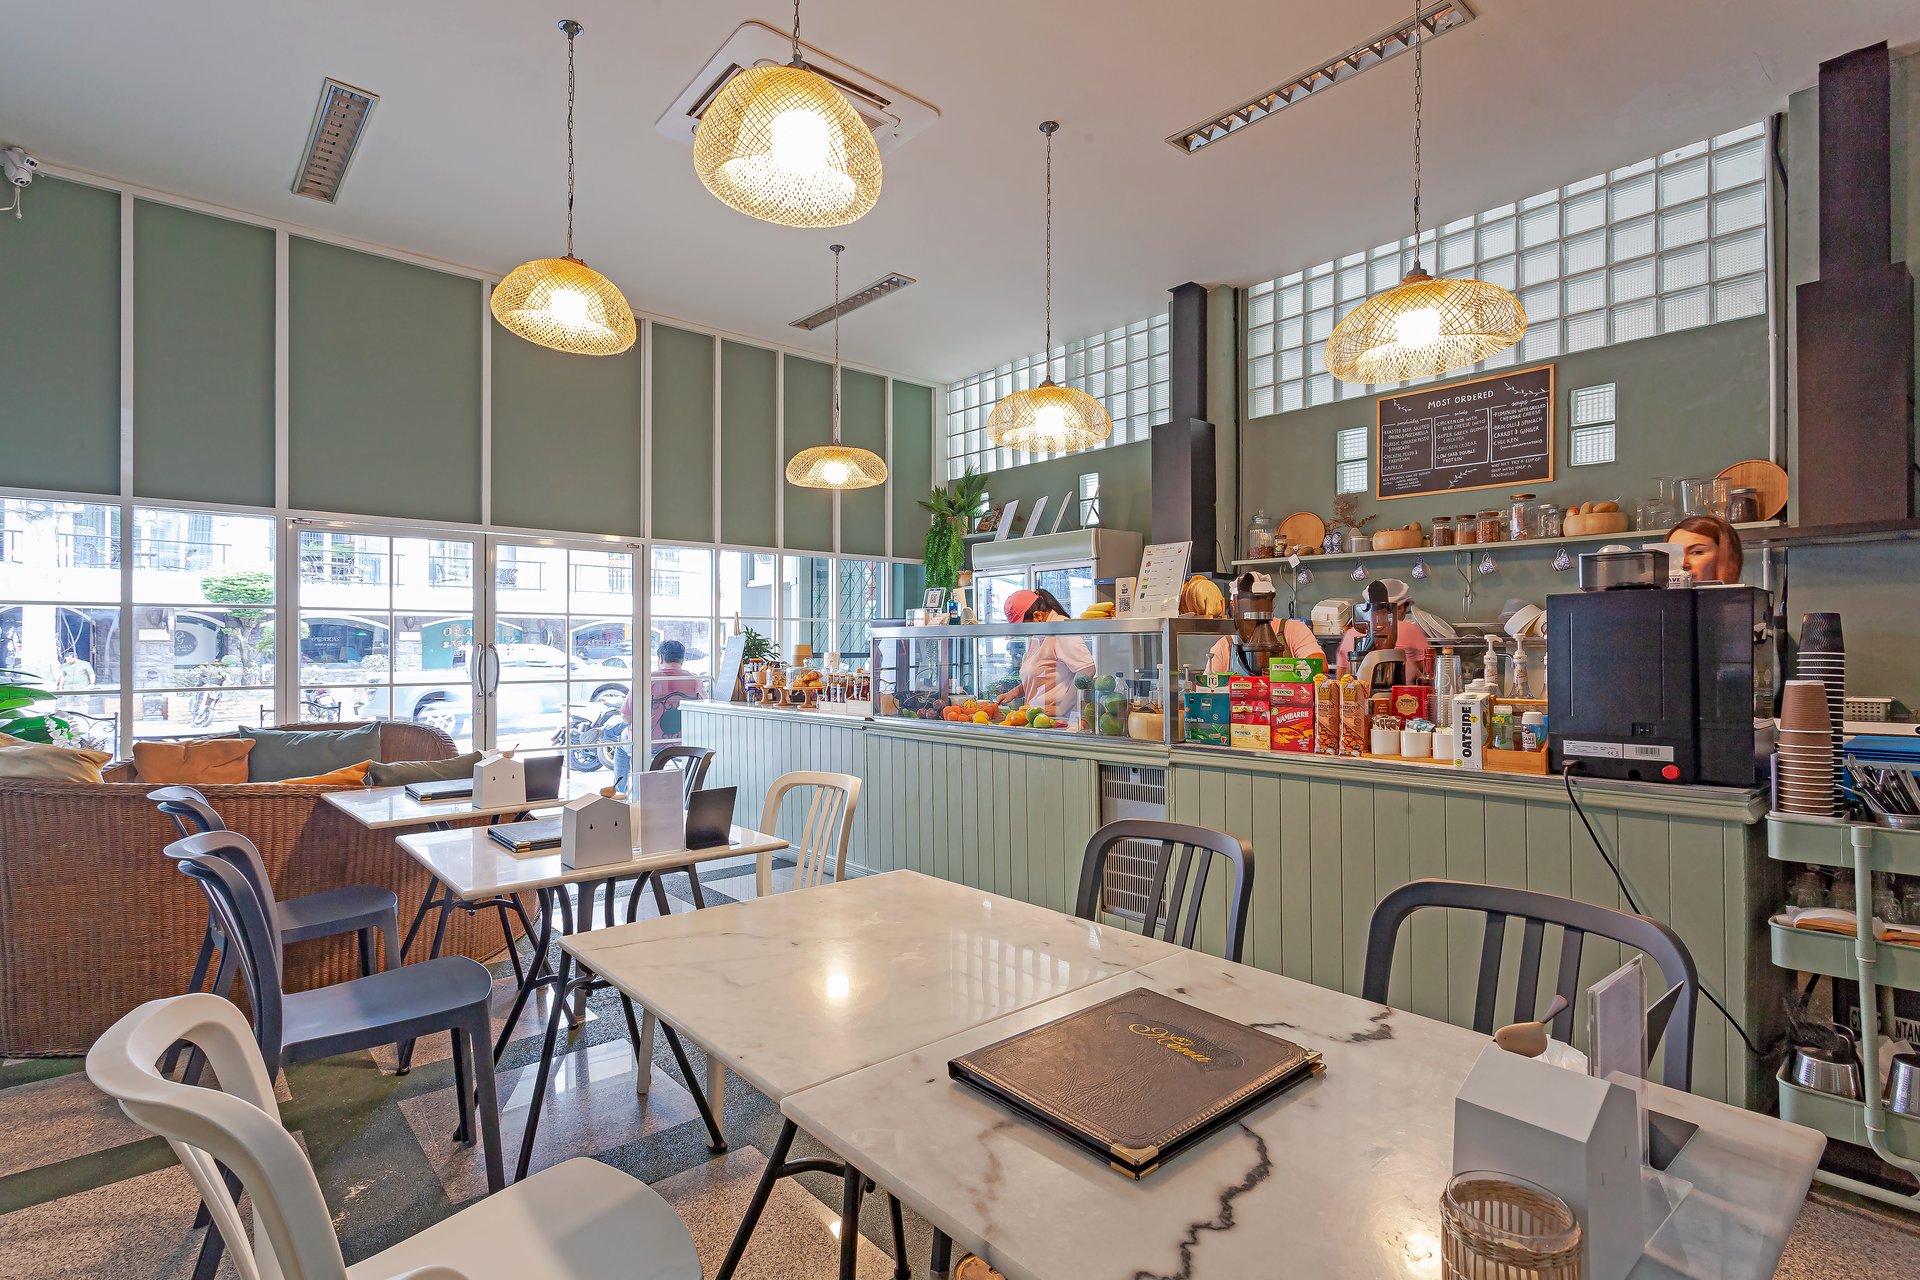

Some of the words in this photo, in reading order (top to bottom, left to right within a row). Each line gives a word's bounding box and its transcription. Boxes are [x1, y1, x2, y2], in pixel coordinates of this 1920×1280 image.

[1427, 397, 1451, 410] MOST
[1454, 390, 1494, 404] ORDERED
[1521, 417, 1543, 426] SPINACH
[1493, 430, 1515, 438] CARROT
[1520, 426, 1540, 434] GINGER
[1494, 437, 1519, 446] CHICKEN
[1276, 710, 1310, 725] NAMBARRIE
[1461, 706, 1473, 758] OATSIDE
[1128, 1023, 1211, 1063] Menu
